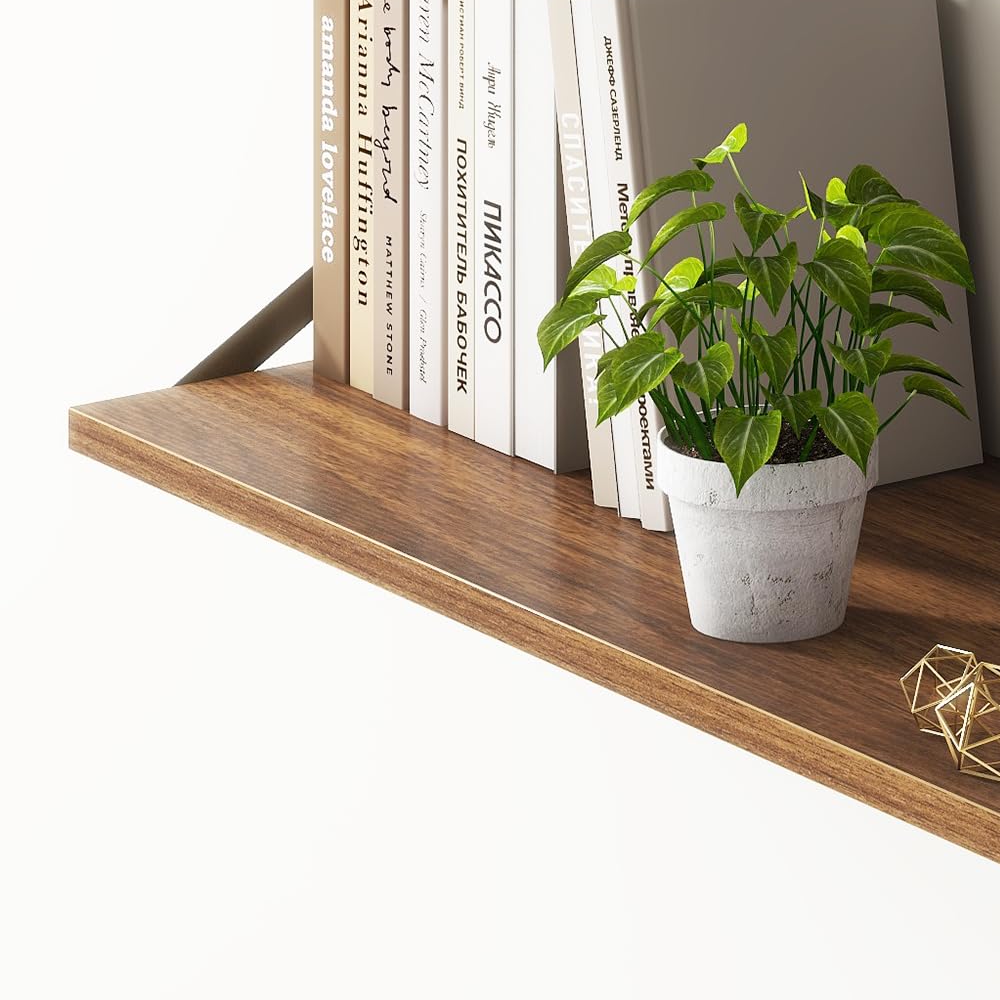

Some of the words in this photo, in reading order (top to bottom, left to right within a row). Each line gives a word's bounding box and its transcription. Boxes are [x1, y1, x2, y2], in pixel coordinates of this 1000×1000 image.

[321, 15, 339, 132] amanda
[482, 62, 501, 95] Анри
[603, 35, 616, 87] ДЖЕФФ
[374, 105, 398, 205] beyond
[414, 52, 435, 190] McCartney
[483, 100, 502, 149] Жидель
[609, 89, 623, 162] САЗЕРЛЕНД
[321, 141, 339, 264] lovelace
[353, 133, 374, 307] Huffington
[456, 138, 468, 285] ПОХИТИТЕЛЬ
[385, 235, 393, 316] MATTHEW
[483, 199, 502, 344] ПИКАССО
[456, 290, 468, 395] БАБОЧЕК
[637, 394, 655, 490] роектами
